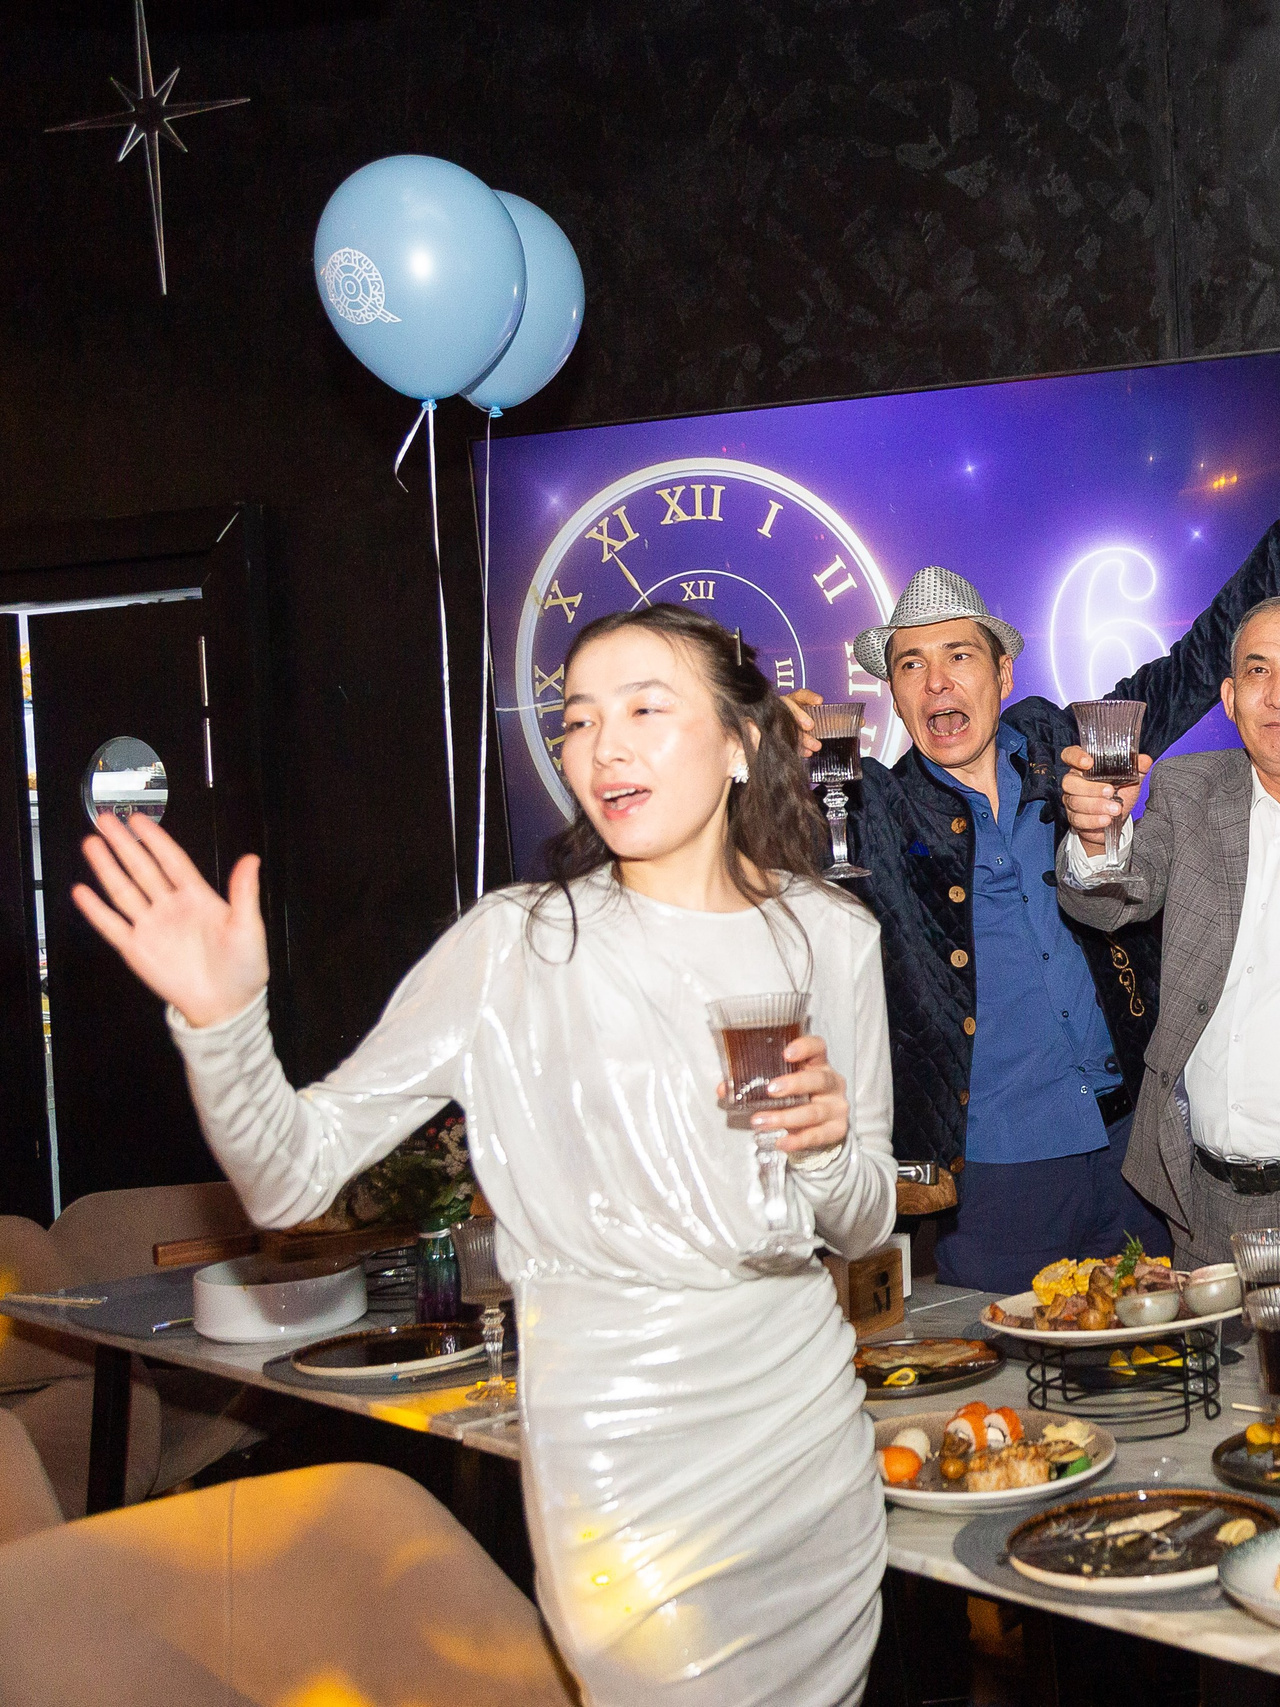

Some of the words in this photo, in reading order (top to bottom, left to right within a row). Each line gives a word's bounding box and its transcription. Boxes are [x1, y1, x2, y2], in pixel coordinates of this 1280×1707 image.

[655, 484, 726, 525] XII
[757, 499, 784, 538] I
[585, 505, 640, 563] XI
[680, 580, 716, 602] XII
[813, 554, 858, 605] II
[545, 580, 583, 624] X
[1050, 547, 1167, 709] 6
[774, 657, 795, 689] III
